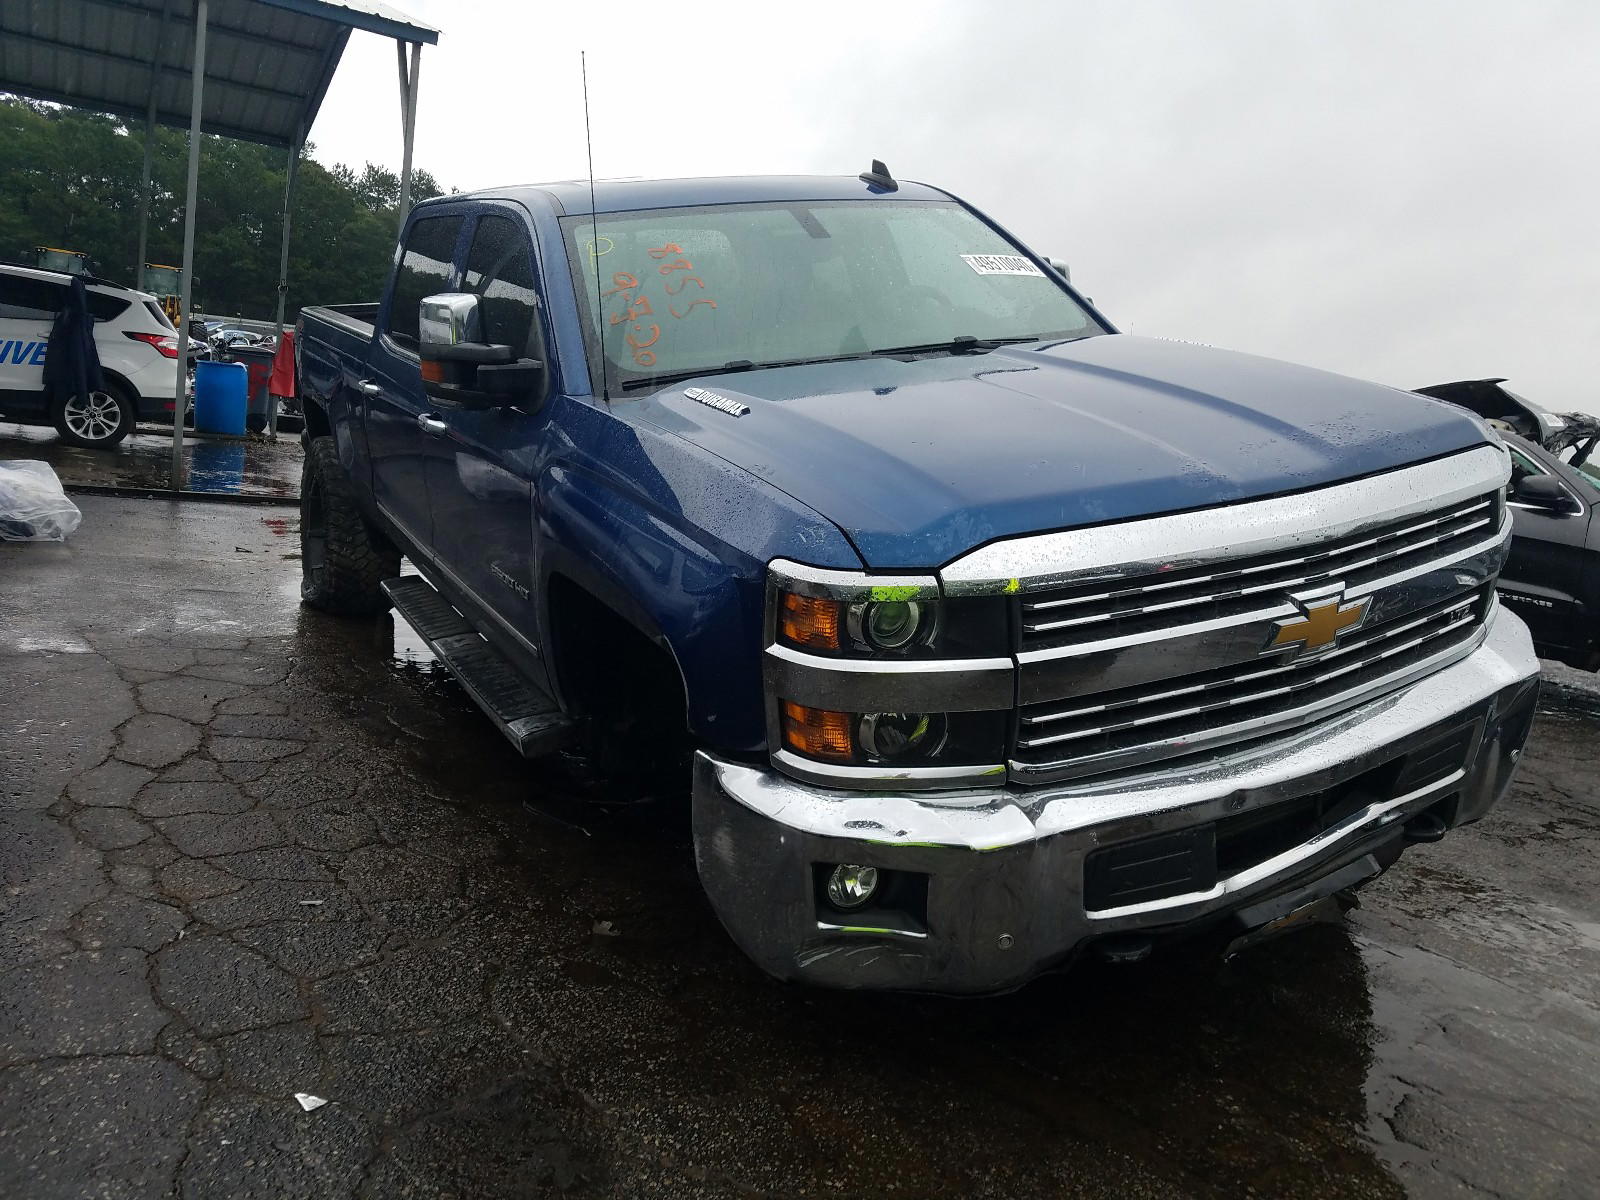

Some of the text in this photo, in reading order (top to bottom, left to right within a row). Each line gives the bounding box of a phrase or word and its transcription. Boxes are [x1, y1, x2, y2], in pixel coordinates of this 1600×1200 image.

[0, 340, 48, 366] IVE
[695, 390, 749, 417] DURAMAX
[1449, 604, 1471, 624] LTZ
